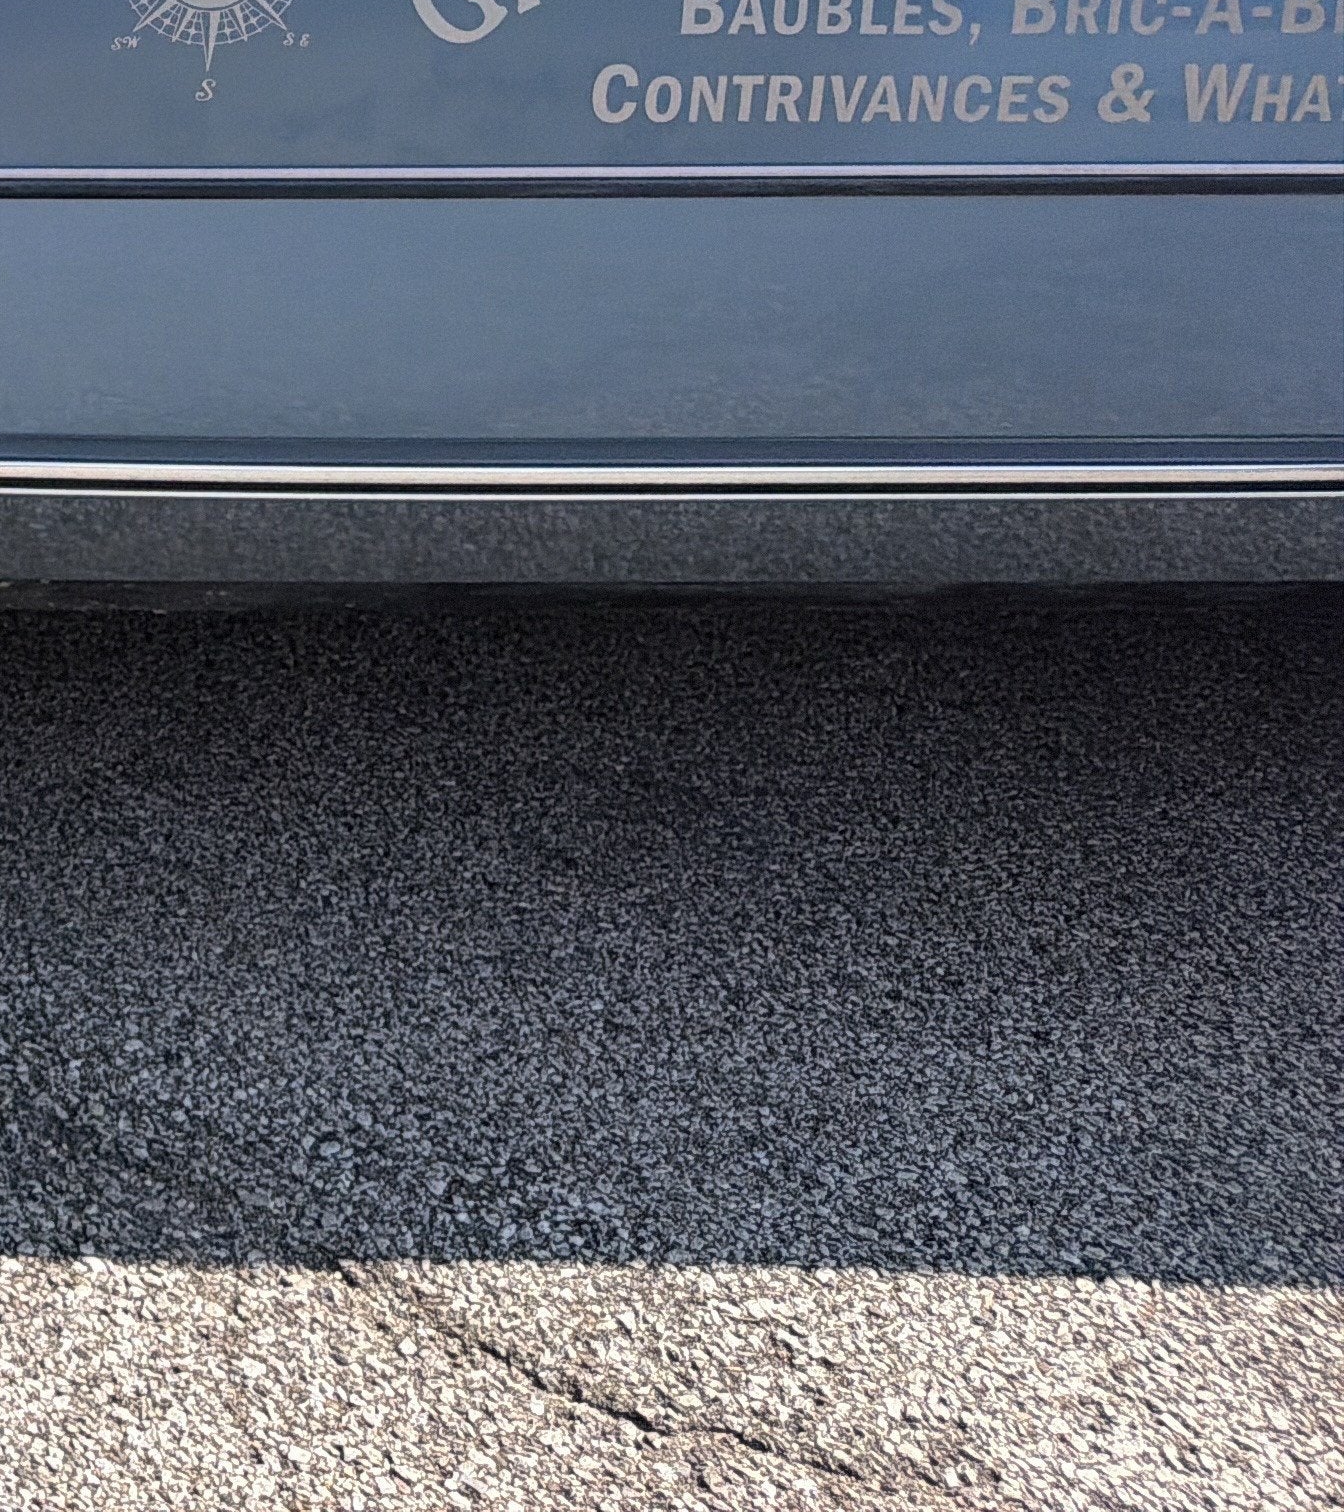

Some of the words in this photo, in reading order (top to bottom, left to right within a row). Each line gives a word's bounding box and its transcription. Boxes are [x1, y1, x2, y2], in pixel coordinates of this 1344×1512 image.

[195, 78, 217, 102] S
[591, 63, 1072, 124] CONTRIVANCES
[1097, 62, 1155, 124] &
[1183, 62, 1344, 124] WHA
